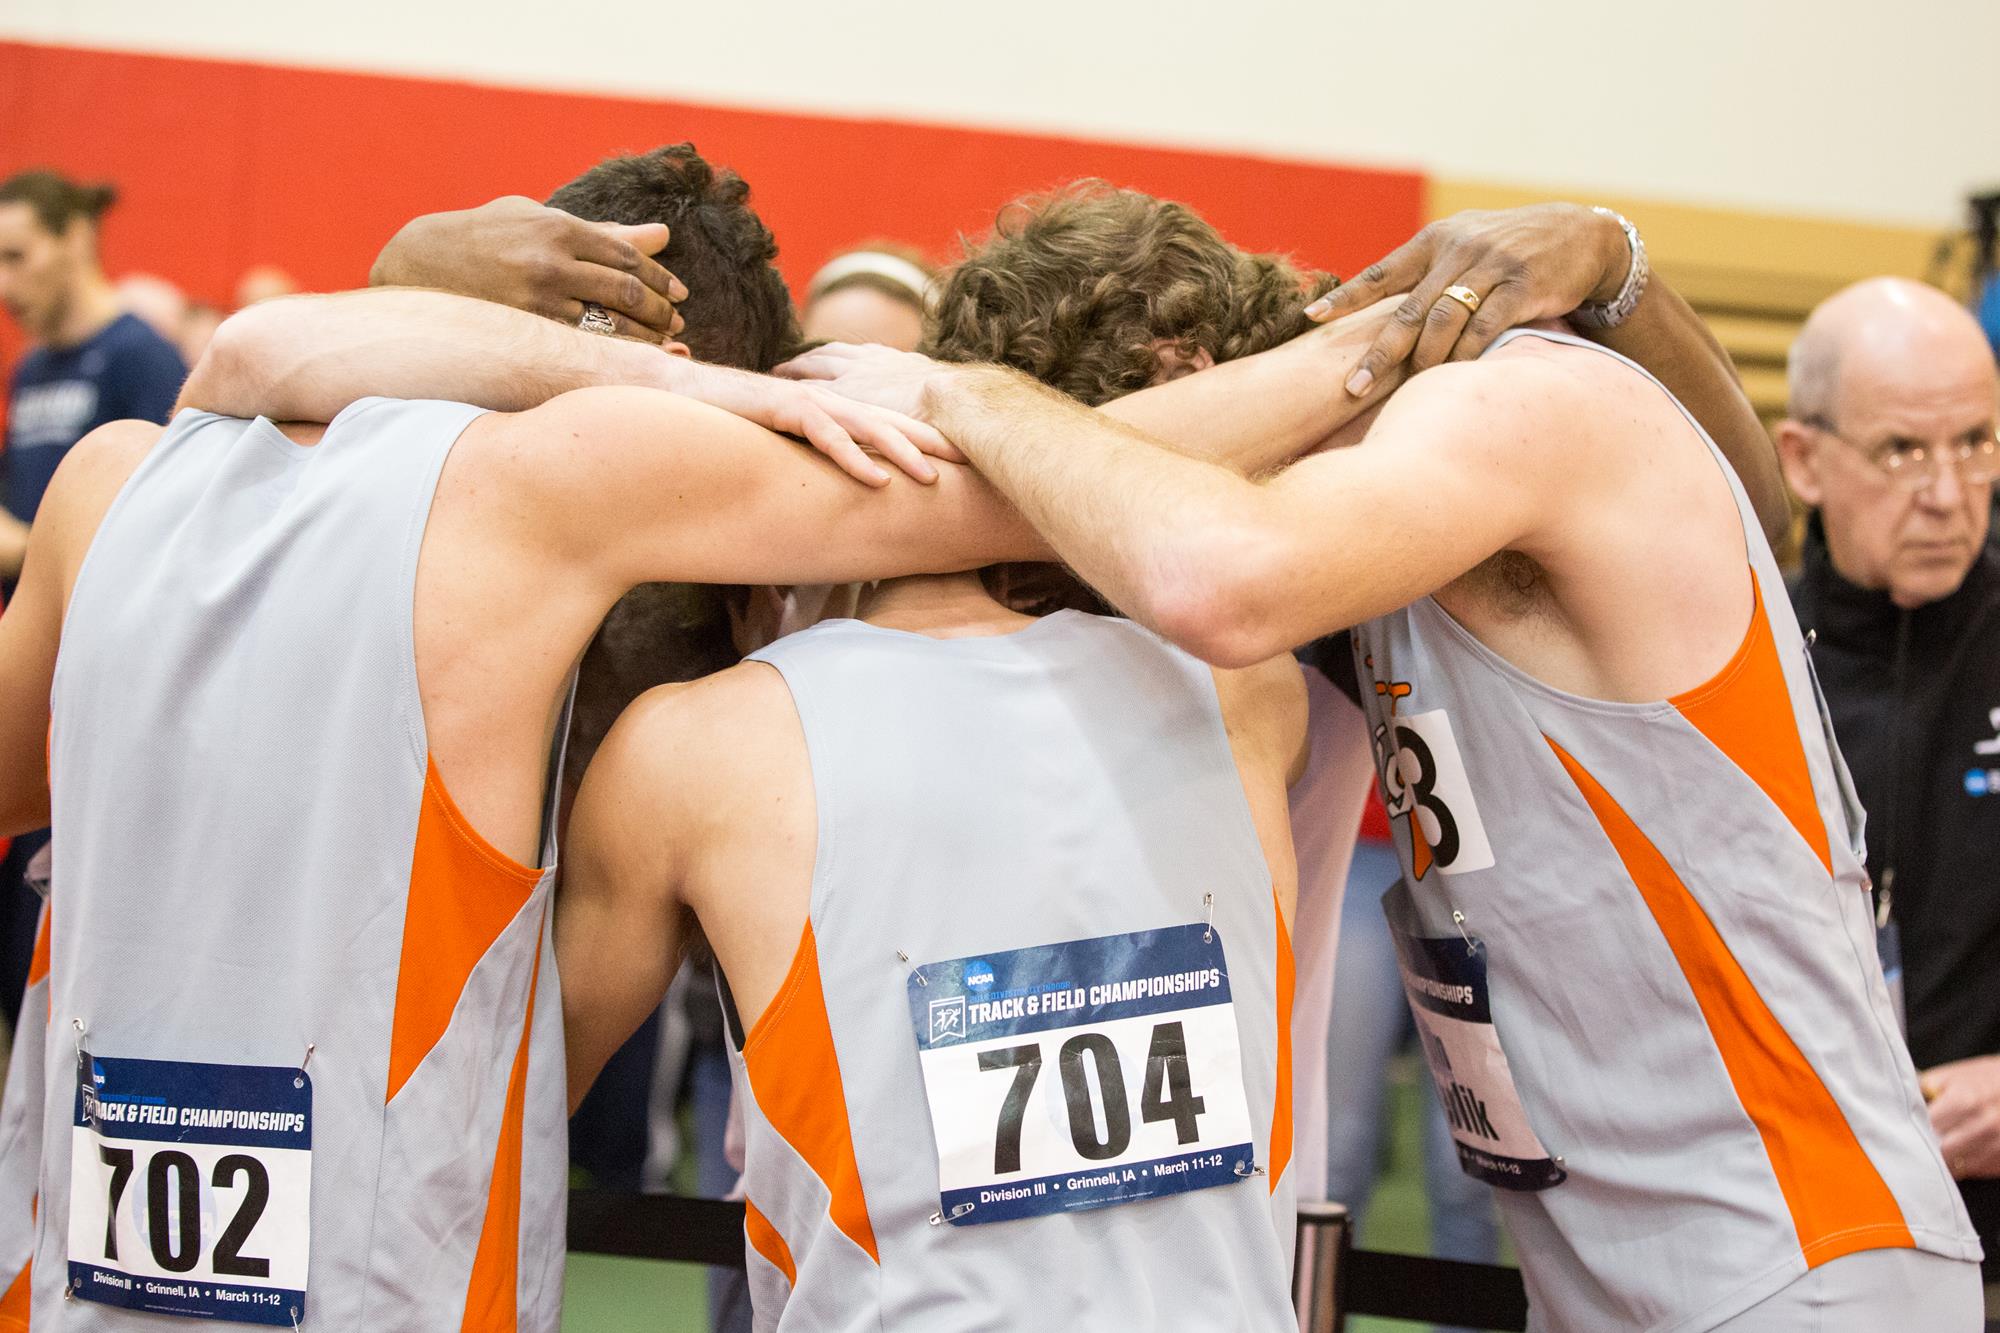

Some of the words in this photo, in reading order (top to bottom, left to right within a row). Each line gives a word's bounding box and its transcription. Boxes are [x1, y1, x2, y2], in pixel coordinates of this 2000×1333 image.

[967, 973, 994, 986] NCAA
[968, 997, 1025, 1025] TRACK
[1027, 995, 1040, 1015] &
[1041, 988, 1086, 1014] FIELD
[1090, 968, 1220, 1006] CHAMPIONSHIPS
[126, 1104, 138, 1123] &
[138, 1105, 178, 1126] FIELD
[180, 1107, 305, 1133] CHAMPIONSHIPS
[977, 1021, 1206, 1175] 704
[980, 1184, 1032, 1204] Division
[1034, 1182, 1047, 1196] III
[1066, 1172, 1121, 1191] Grinnell,
[1122, 1169, 1136, 1183] IA
[1154, 1159, 1189, 1178] March
[1192, 1154, 1223, 1171] 11-12
[99, 1143, 270, 1278] 702
[93, 1271, 124, 1289] Division
[124, 1278, 132, 1290] III
[145, 1282, 187, 1299] Grinnell,
[188, 1287, 200, 1298] IA
[216, 1289, 250, 1303] March
[252, 1292, 281, 1306] 11-12
